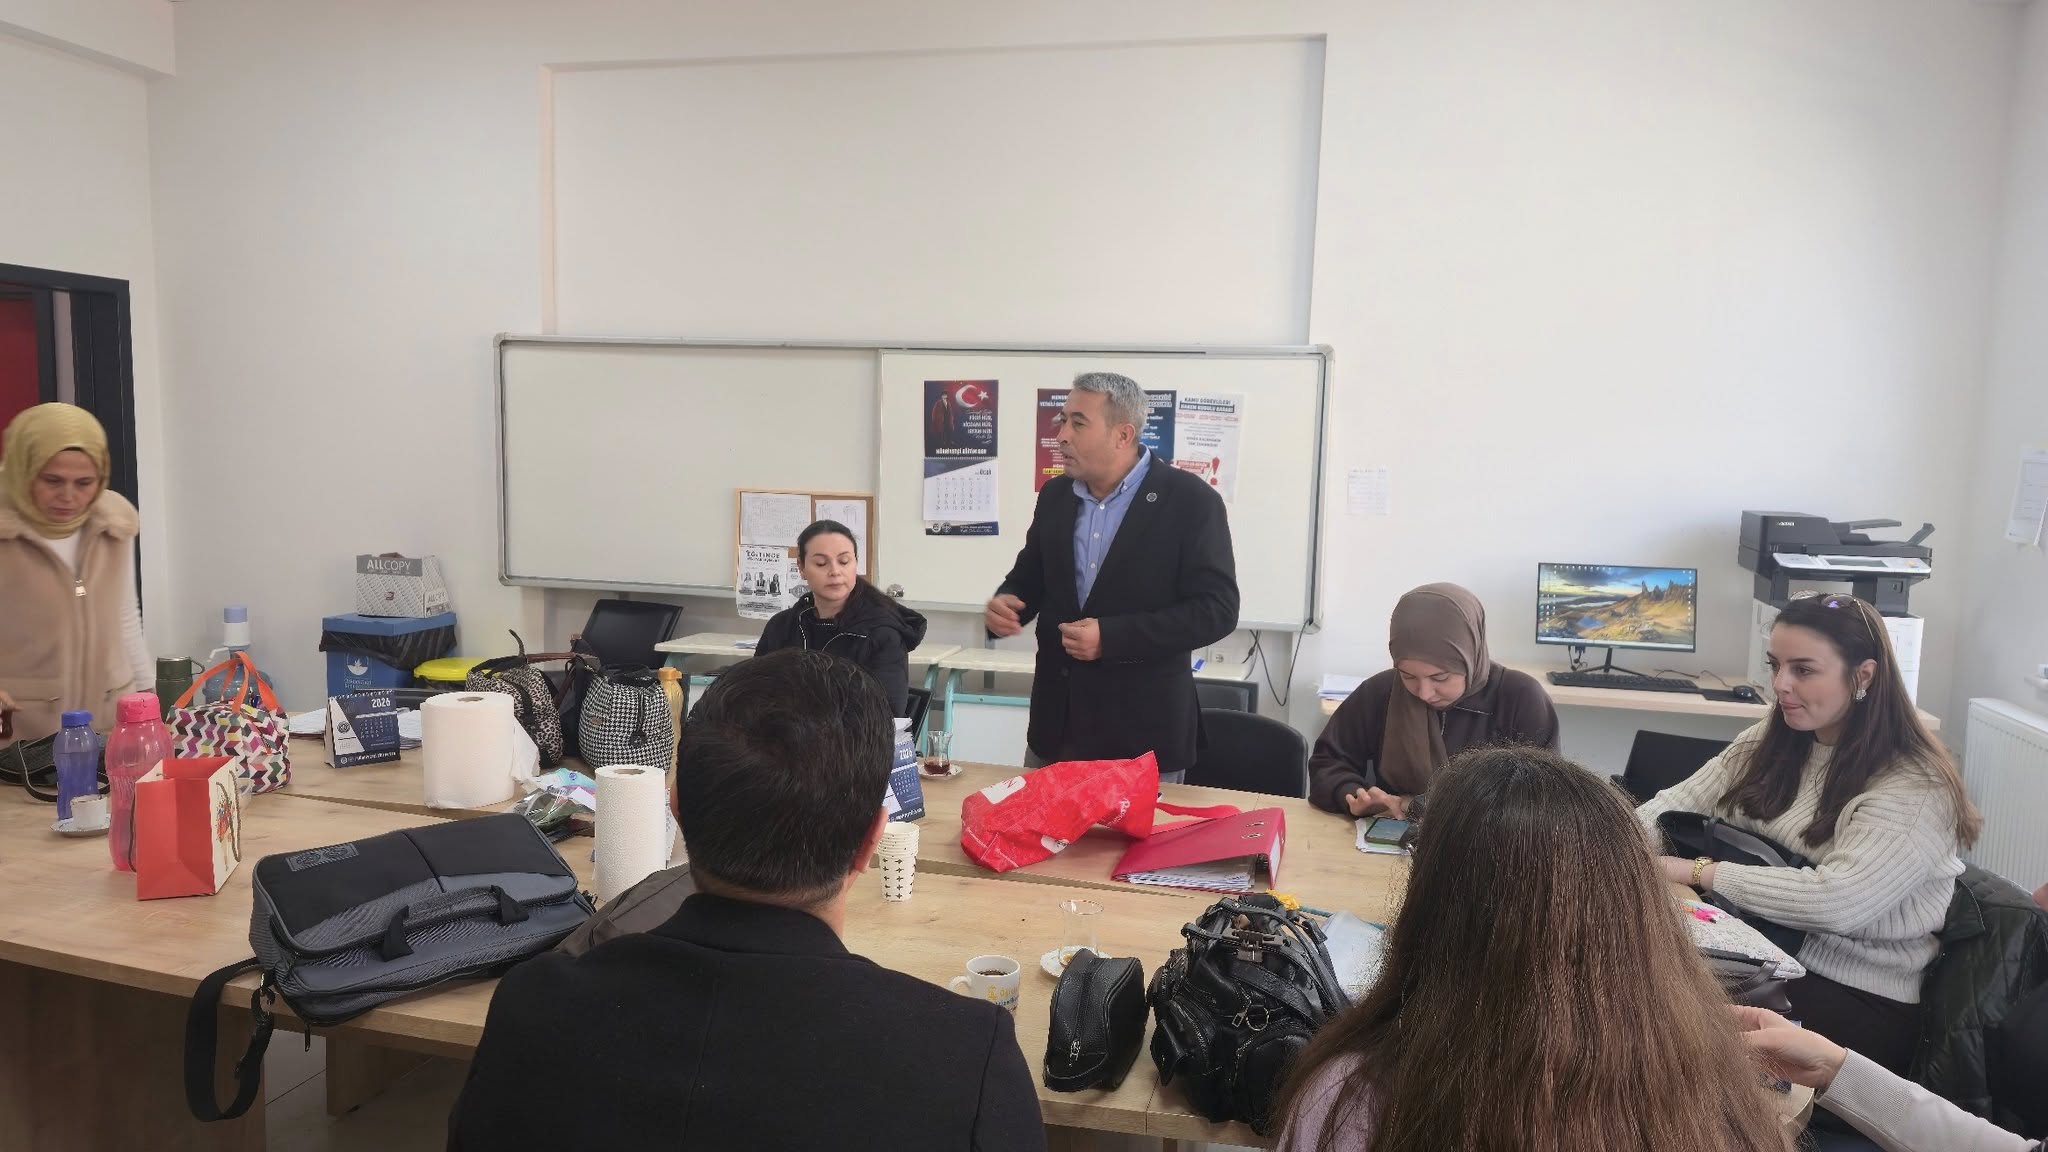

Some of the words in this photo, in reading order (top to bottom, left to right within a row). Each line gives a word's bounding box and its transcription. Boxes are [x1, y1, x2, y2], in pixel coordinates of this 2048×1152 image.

[367, 559, 411, 571] ALLCOPY
[371, 697, 391, 708] 2026
[899, 748, 913, 760] 2026
